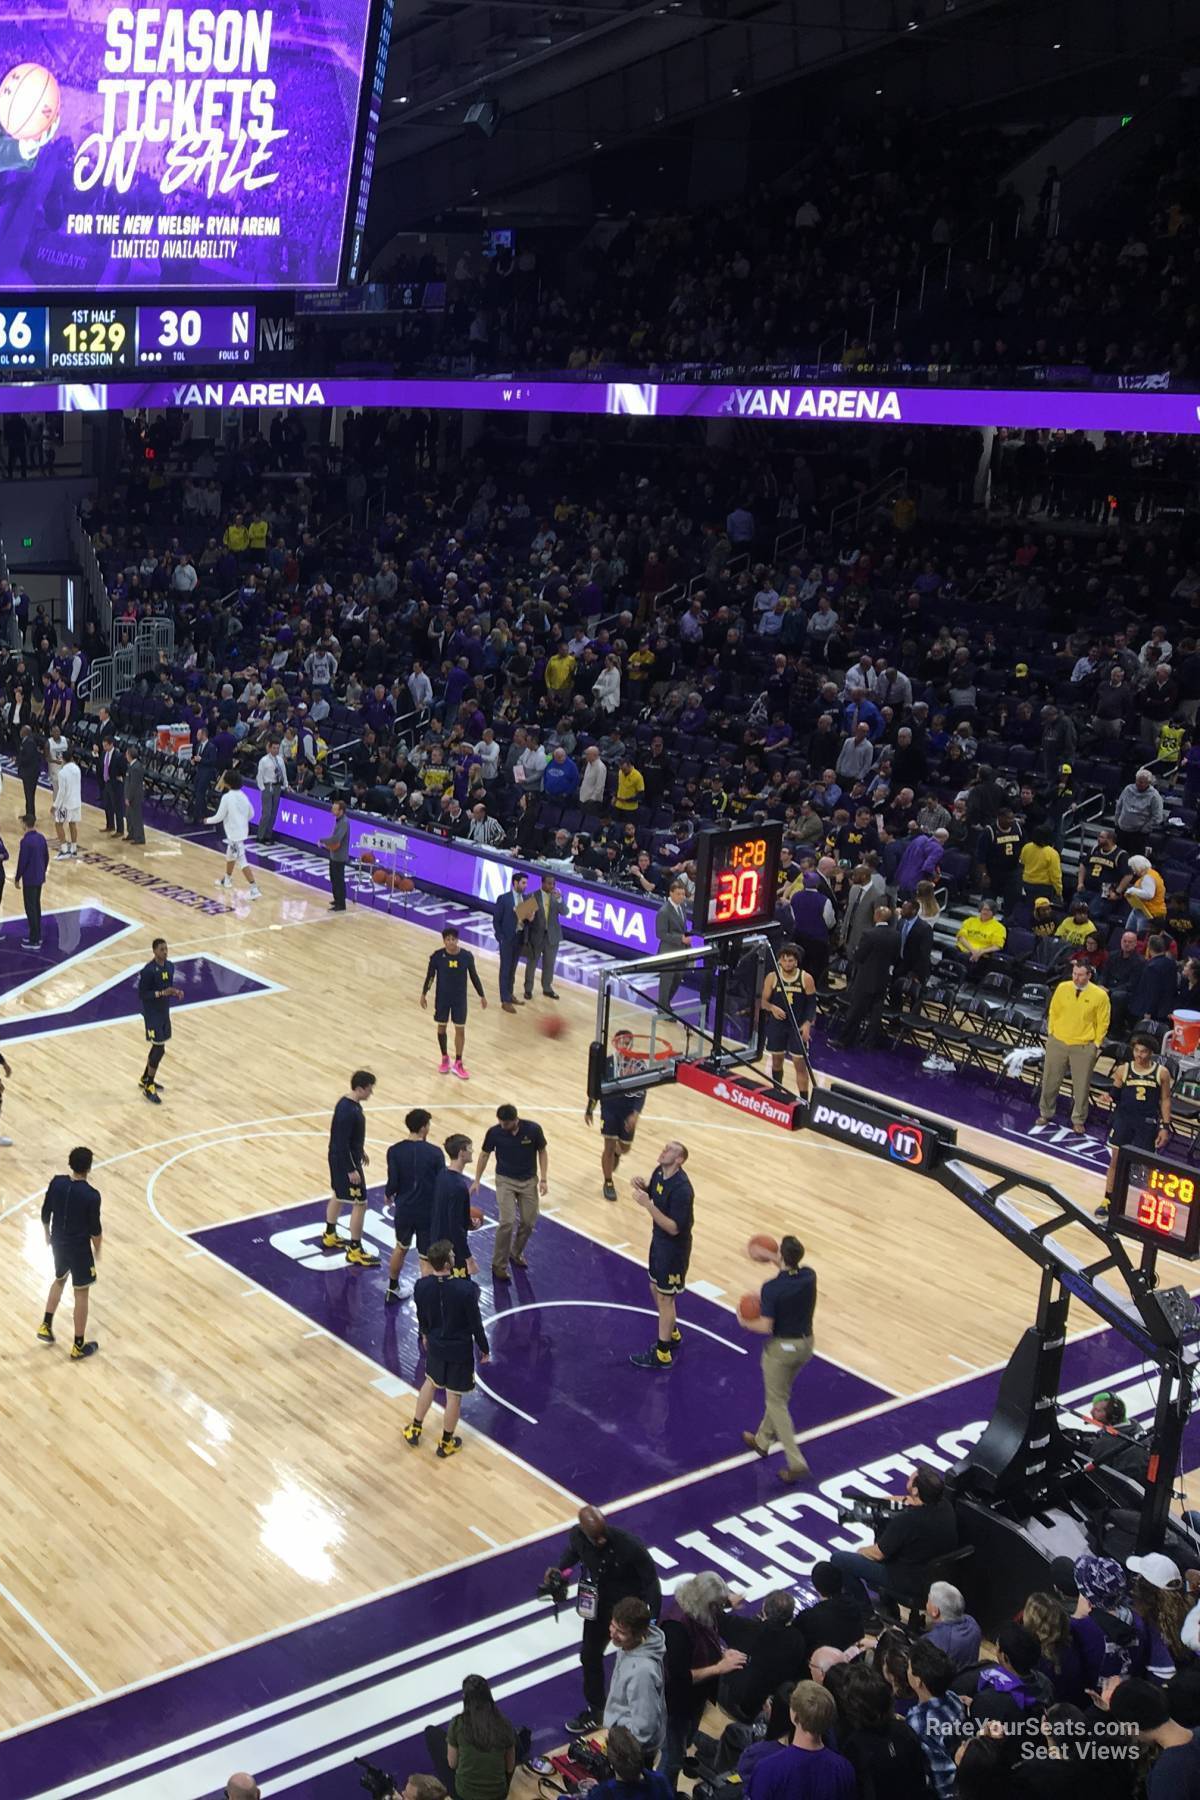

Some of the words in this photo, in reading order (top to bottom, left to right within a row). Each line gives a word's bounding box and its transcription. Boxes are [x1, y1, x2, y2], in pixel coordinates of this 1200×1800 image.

[104, 8, 272, 72] SEASON
[98, 79, 276, 142] TICKETS
[74, 123, 146, 194] ON
[159, 128, 289, 199] SALE
[67, 214, 92, 234] FOR
[96, 215, 120, 234] THE
[123, 215, 154, 234] NEW
[158, 216, 203, 235] WELSH-
[207, 216, 239, 235] RYAN
[241, 217, 280, 236] ARENA
[111, 240, 158, 258] LIMITED
[162, 240, 237, 258] AVAILABILITY
[72, 311, 88, 323] 1ST
[91, 310, 116, 322] HALF
[158, 310, 202, 346] 30
[232, 312, 249, 344] N
[63, 323, 125, 352] 1:29
[52, 353, 113, 366] POSSESSION
[173, 352, 185, 361] TOL
[219, 351, 239, 360] FOULS
[244, 351, 249, 360] 0
[59, 384, 107, 410] N
[229, 383, 325, 406] ARENA
[606, 383, 657, 416] N
[796, 390, 901, 420] ARENA
[732, 840, 766, 868] 1:28
[718, 870, 758, 920] 30
[1135, 1086, 1146, 1100] 2
[814, 1104, 888, 1146] proven
[896, 1133, 915, 1155] IT
[1151, 1170, 1194, 1203] 1:28
[1140, 1192, 1175, 1231] 30
